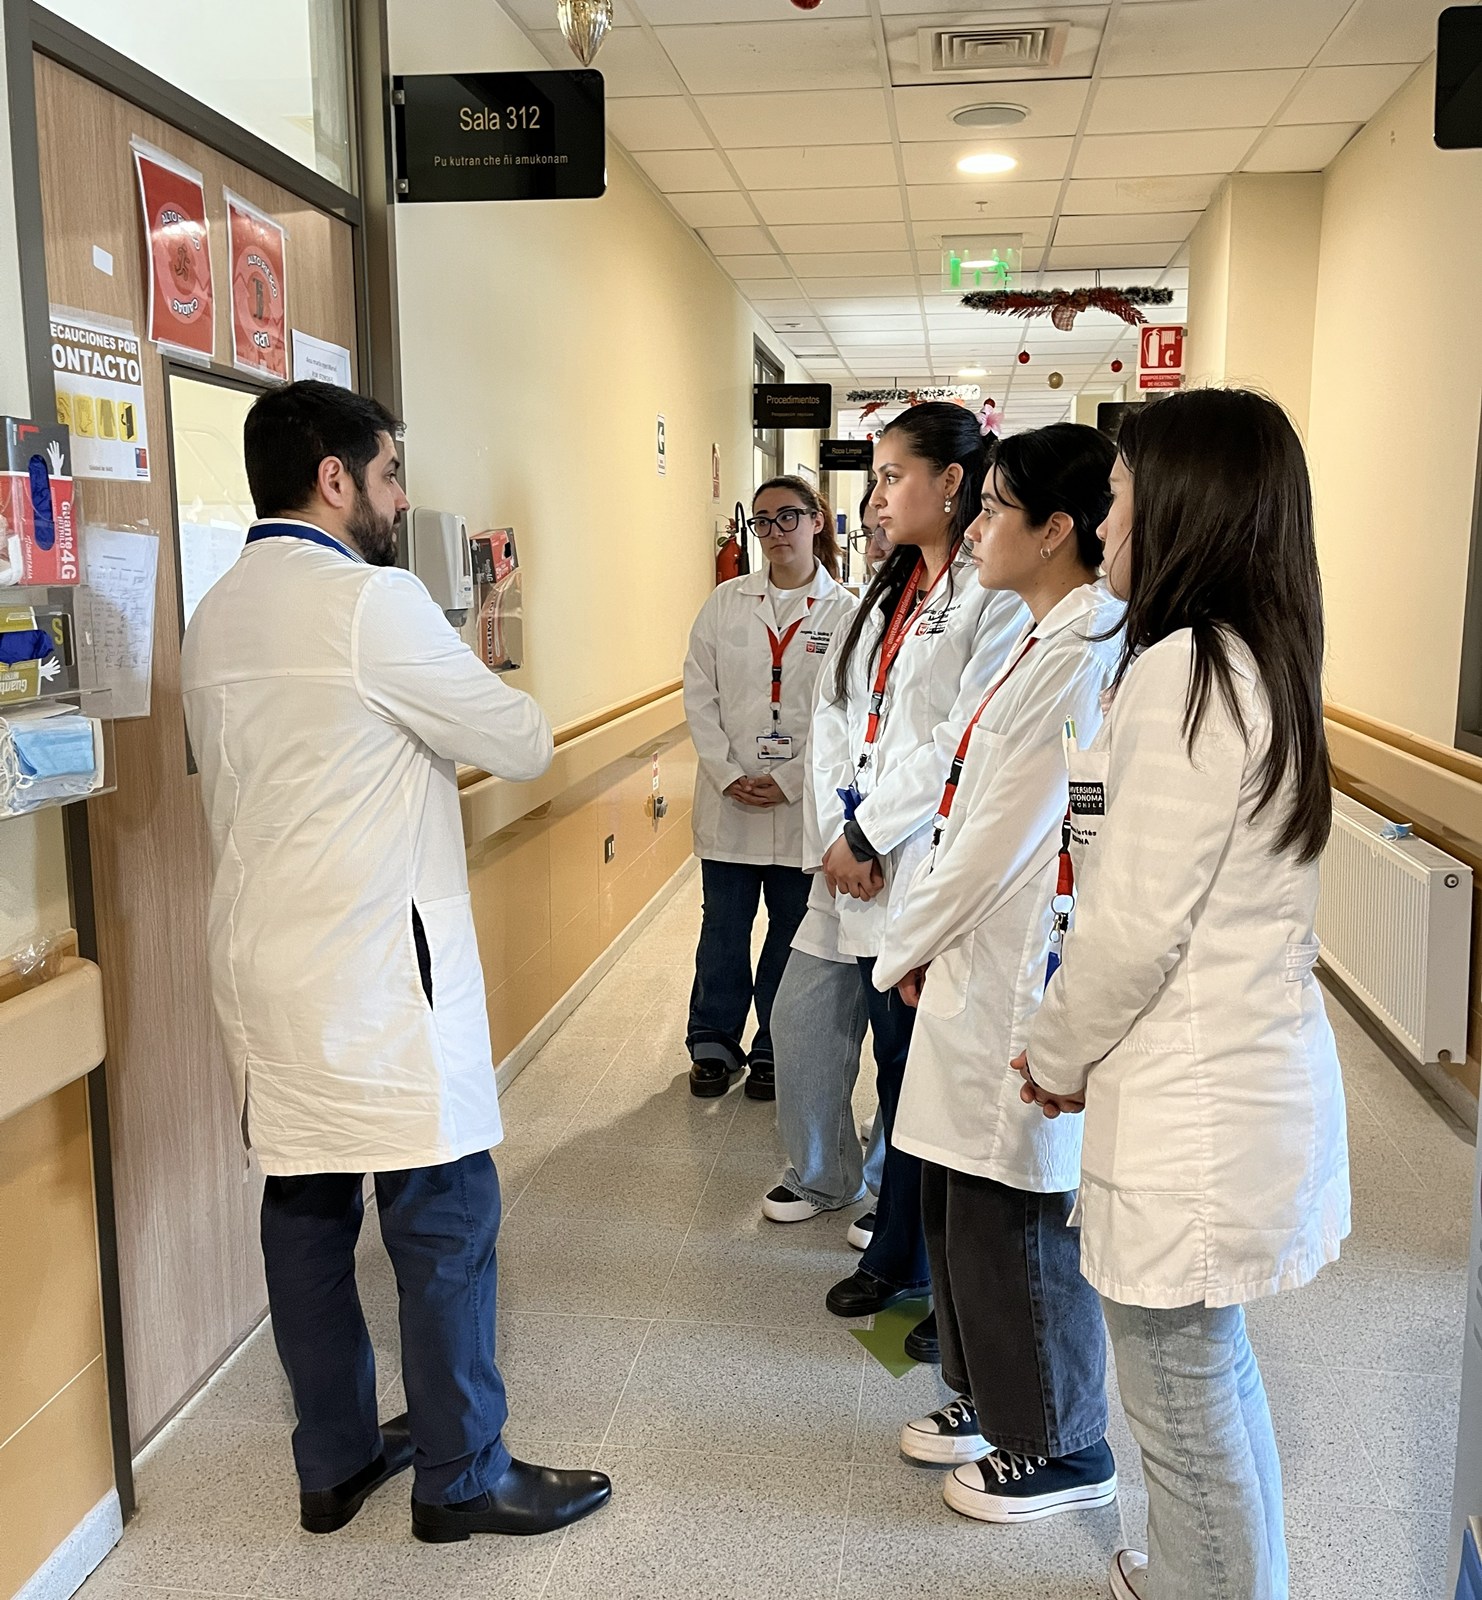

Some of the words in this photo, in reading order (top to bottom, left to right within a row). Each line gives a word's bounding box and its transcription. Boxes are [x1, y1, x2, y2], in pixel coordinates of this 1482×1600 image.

[460, 107, 500, 131] Sala
[506, 106, 540, 129] 312
[434, 156, 447, 166] Pu
[450, 156, 480, 166] kutran
[483, 155, 500, 166] che
[503, 154, 512, 165] ñi
[515, 154, 568, 164] amukonam
[50, 322, 116, 350] ECAUCIONES
[118, 339, 138, 355] POR
[52, 343, 140, 382] ONTACTO
[766, 395, 820, 404] Procedimientos
